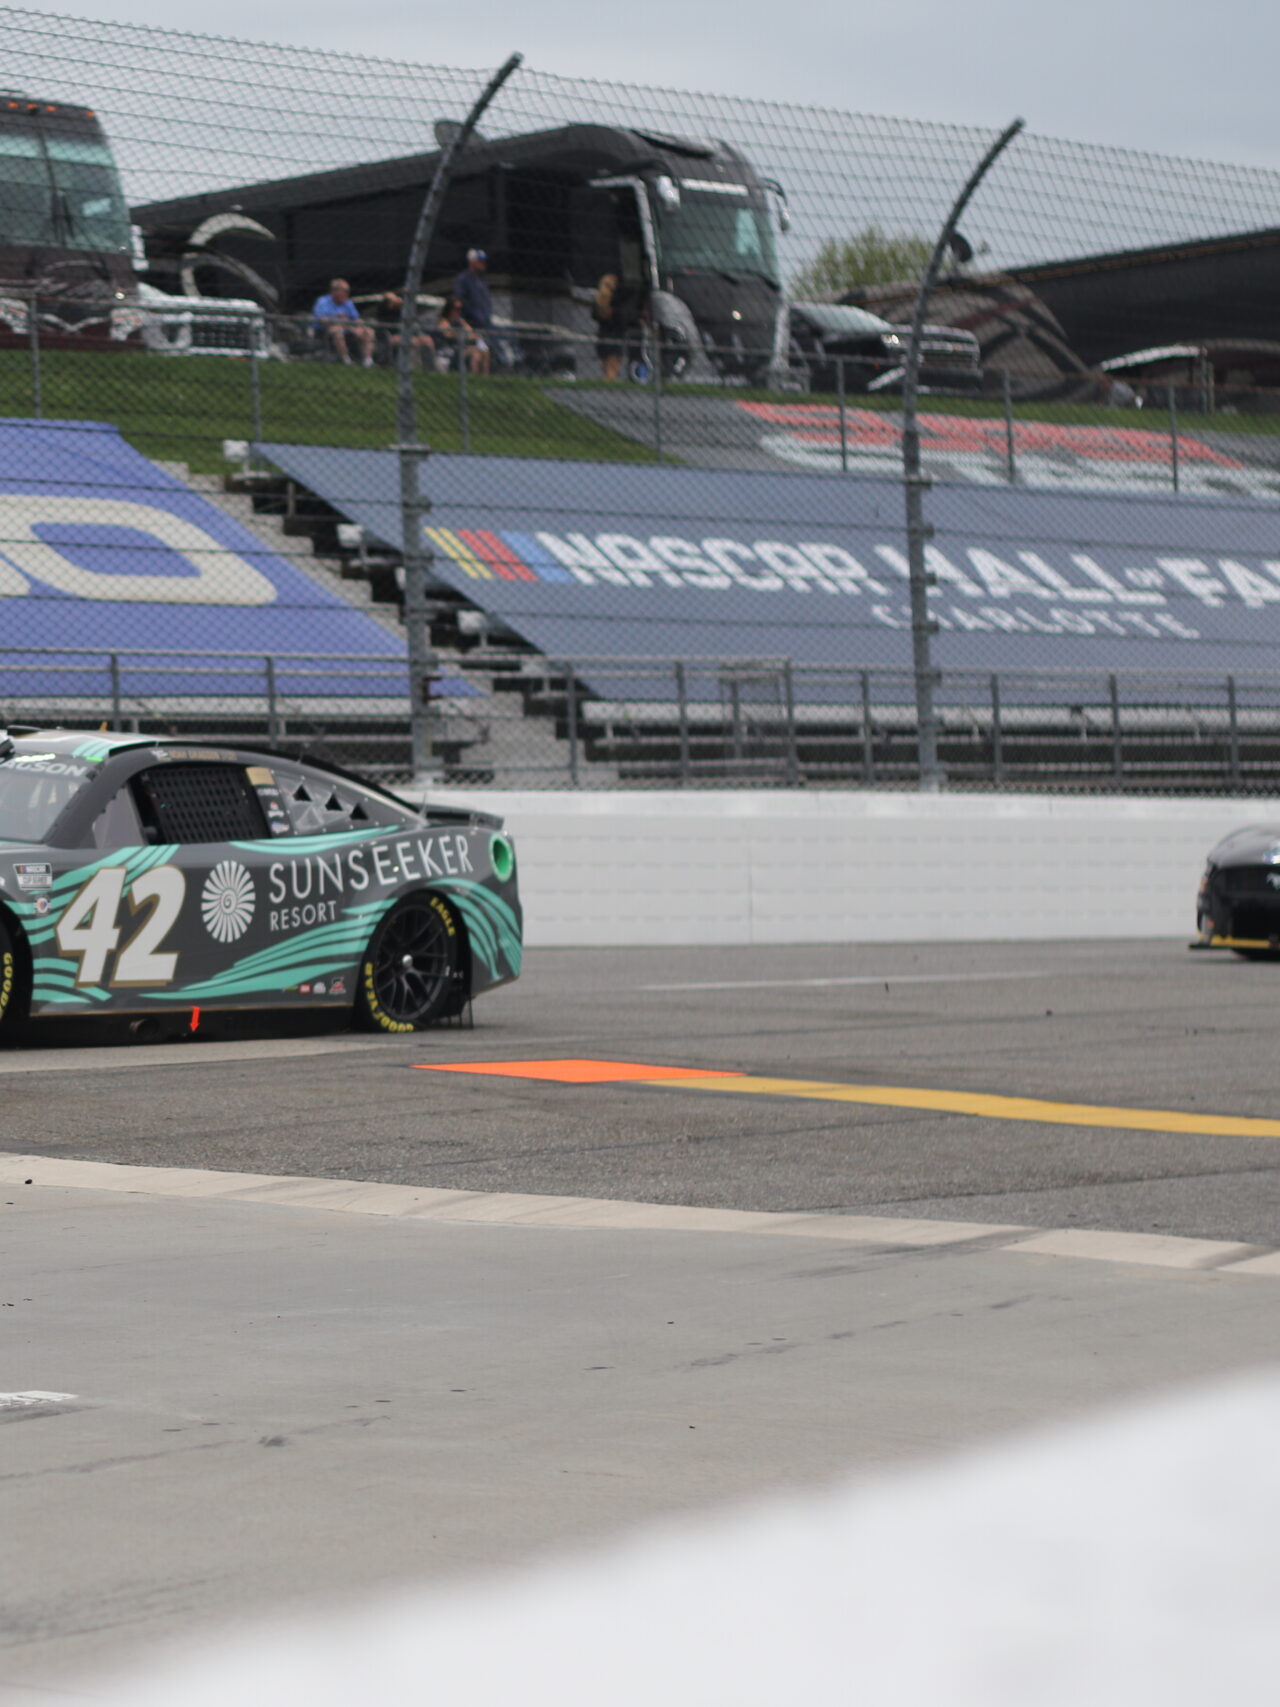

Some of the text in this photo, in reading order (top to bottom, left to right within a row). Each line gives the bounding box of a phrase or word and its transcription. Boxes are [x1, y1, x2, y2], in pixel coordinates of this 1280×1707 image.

[535, 531, 892, 595] NASCAR
[874, 545, 1167, 604] HALL
[871, 604, 1200, 639] CHARLOTTE
[269, 835, 474, 904] SUNSEEKER
[54, 865, 186, 987] 42
[271, 901, 337, 931] RESORT
[430, 897, 456, 936] EAGLE
[365, 962, 414, 1032] GOODYEAR
